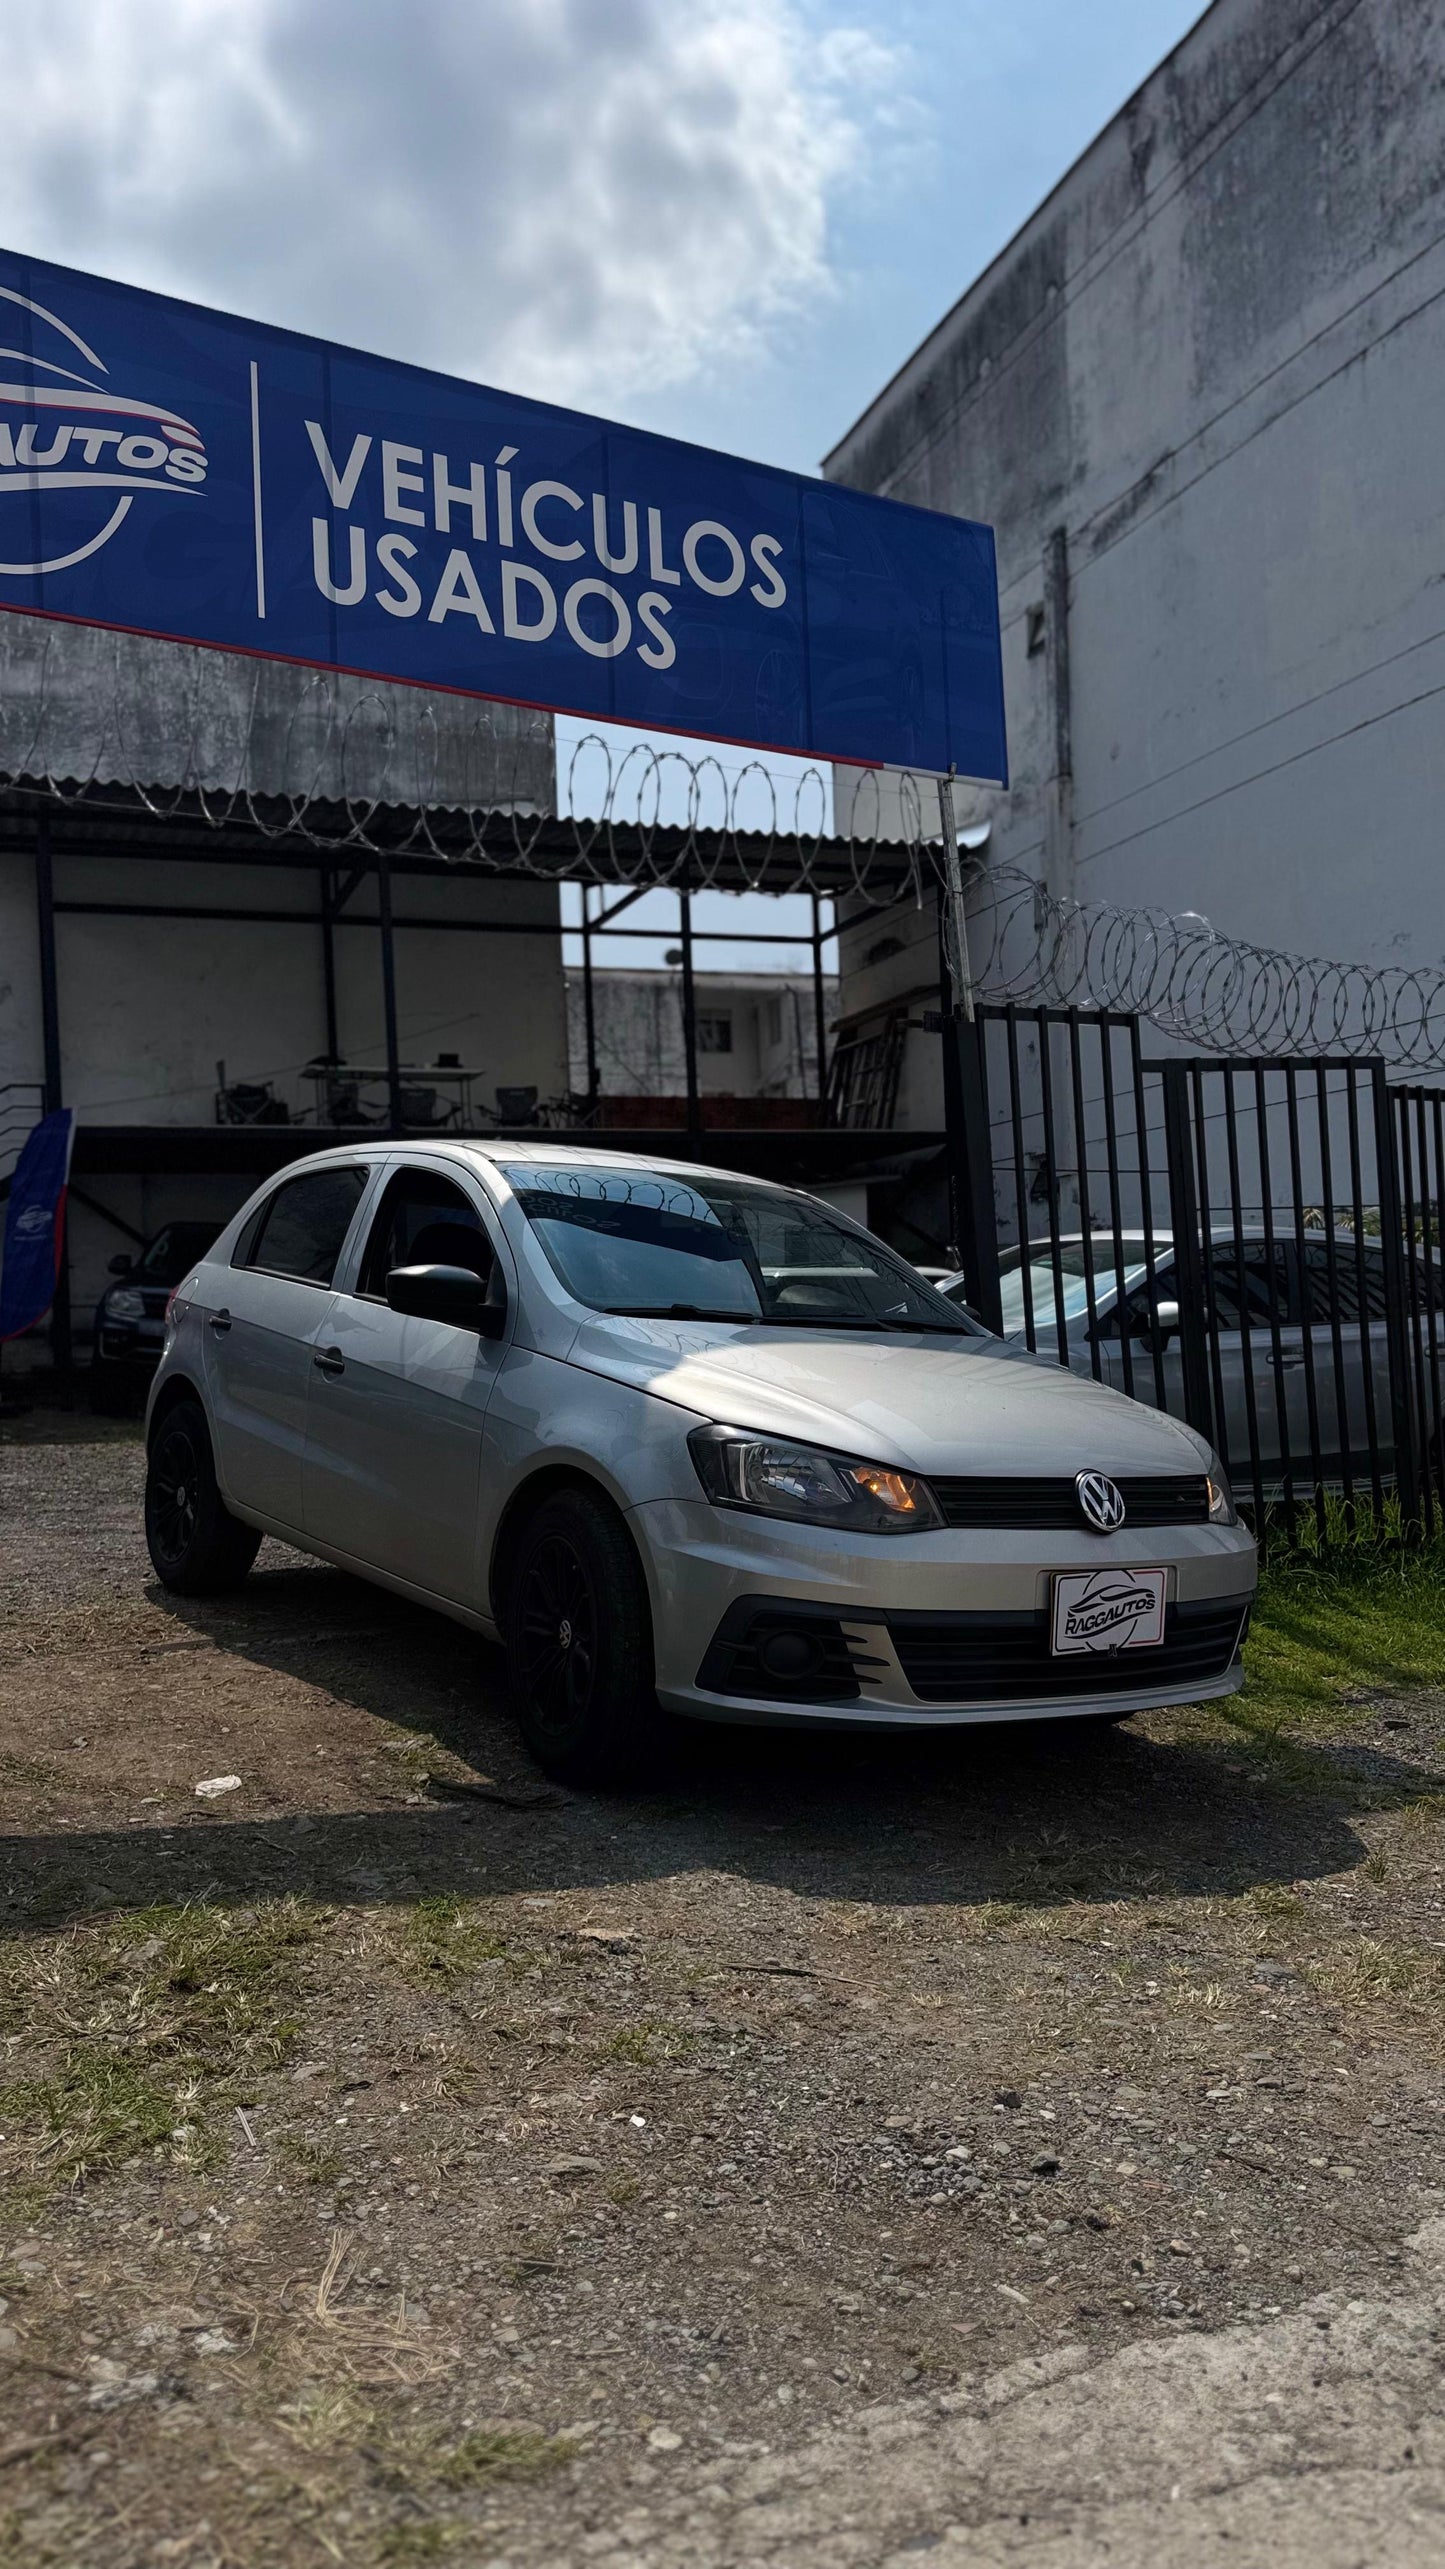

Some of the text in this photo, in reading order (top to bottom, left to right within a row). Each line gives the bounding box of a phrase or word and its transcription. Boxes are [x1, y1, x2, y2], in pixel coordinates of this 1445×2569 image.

[304, 420, 787, 608] VEHÍCULOS
[312, 517, 676, 670] USADOS
[1064, 1598, 1156, 1636] RAGGAUTOS
